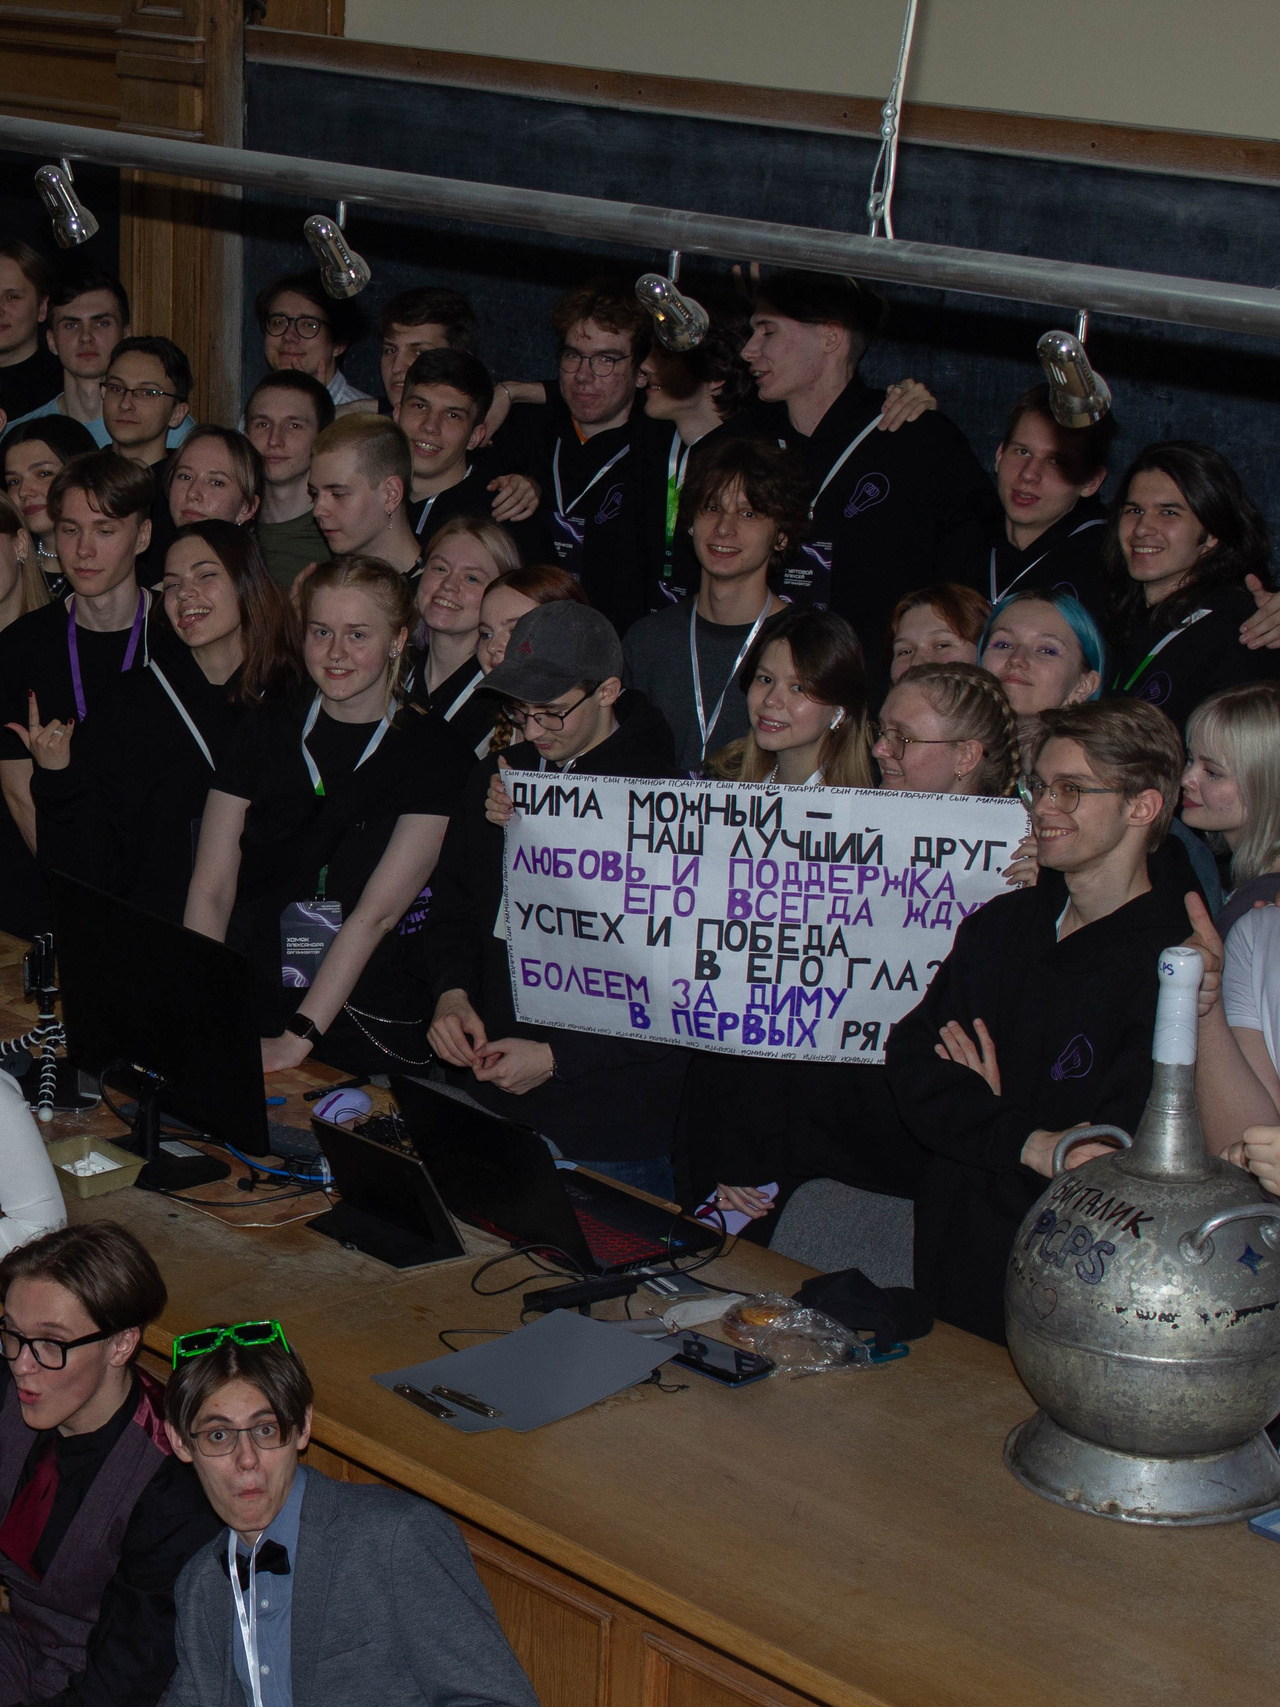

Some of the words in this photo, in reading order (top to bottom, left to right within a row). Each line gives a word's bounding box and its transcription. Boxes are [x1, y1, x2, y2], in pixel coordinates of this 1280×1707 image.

[504, 769, 520, 777] СЫН
[602, 776, 620, 785] СЫН
[716, 780, 734, 789] СЫН
[830, 787, 851, 795] СЫН
[949, 795, 970, 803] СЫН
[512, 782, 604, 820] ДИМА
[628, 789, 783, 829] МОЖНЫЙ
[627, 821, 704, 856] НАШ
[729, 826, 884, 866] ЛУЧШИЙ
[910, 836, 1008, 873] ДРУГ,
[512, 845, 646, 883] ЛЮБОВЬ
[672, 854, 700, 886] И
[728, 857, 956, 900] ПОДДЕРЖКА
[514, 901, 625, 945] УСПЕХ
[646, 915, 672, 948] И
[696, 917, 850, 958] ПОБЕДА
[623, 882, 696, 917] ЕГО
[726, 888, 874, 927] ВСЕГДА
[520, 957, 651, 1004] БОЛЕЕМ
[671, 977, 719, 1013] ЗА
[745, 983, 849, 1020] ДИМУ
[694, 948, 722, 981] В
[746, 952, 824, 988] ЕГО
[628, 1001, 651, 1030] В
[671, 1007, 821, 1049] ПЕРВЫХ
[1051, 1176, 1154, 1239] ВИТАЛИК
